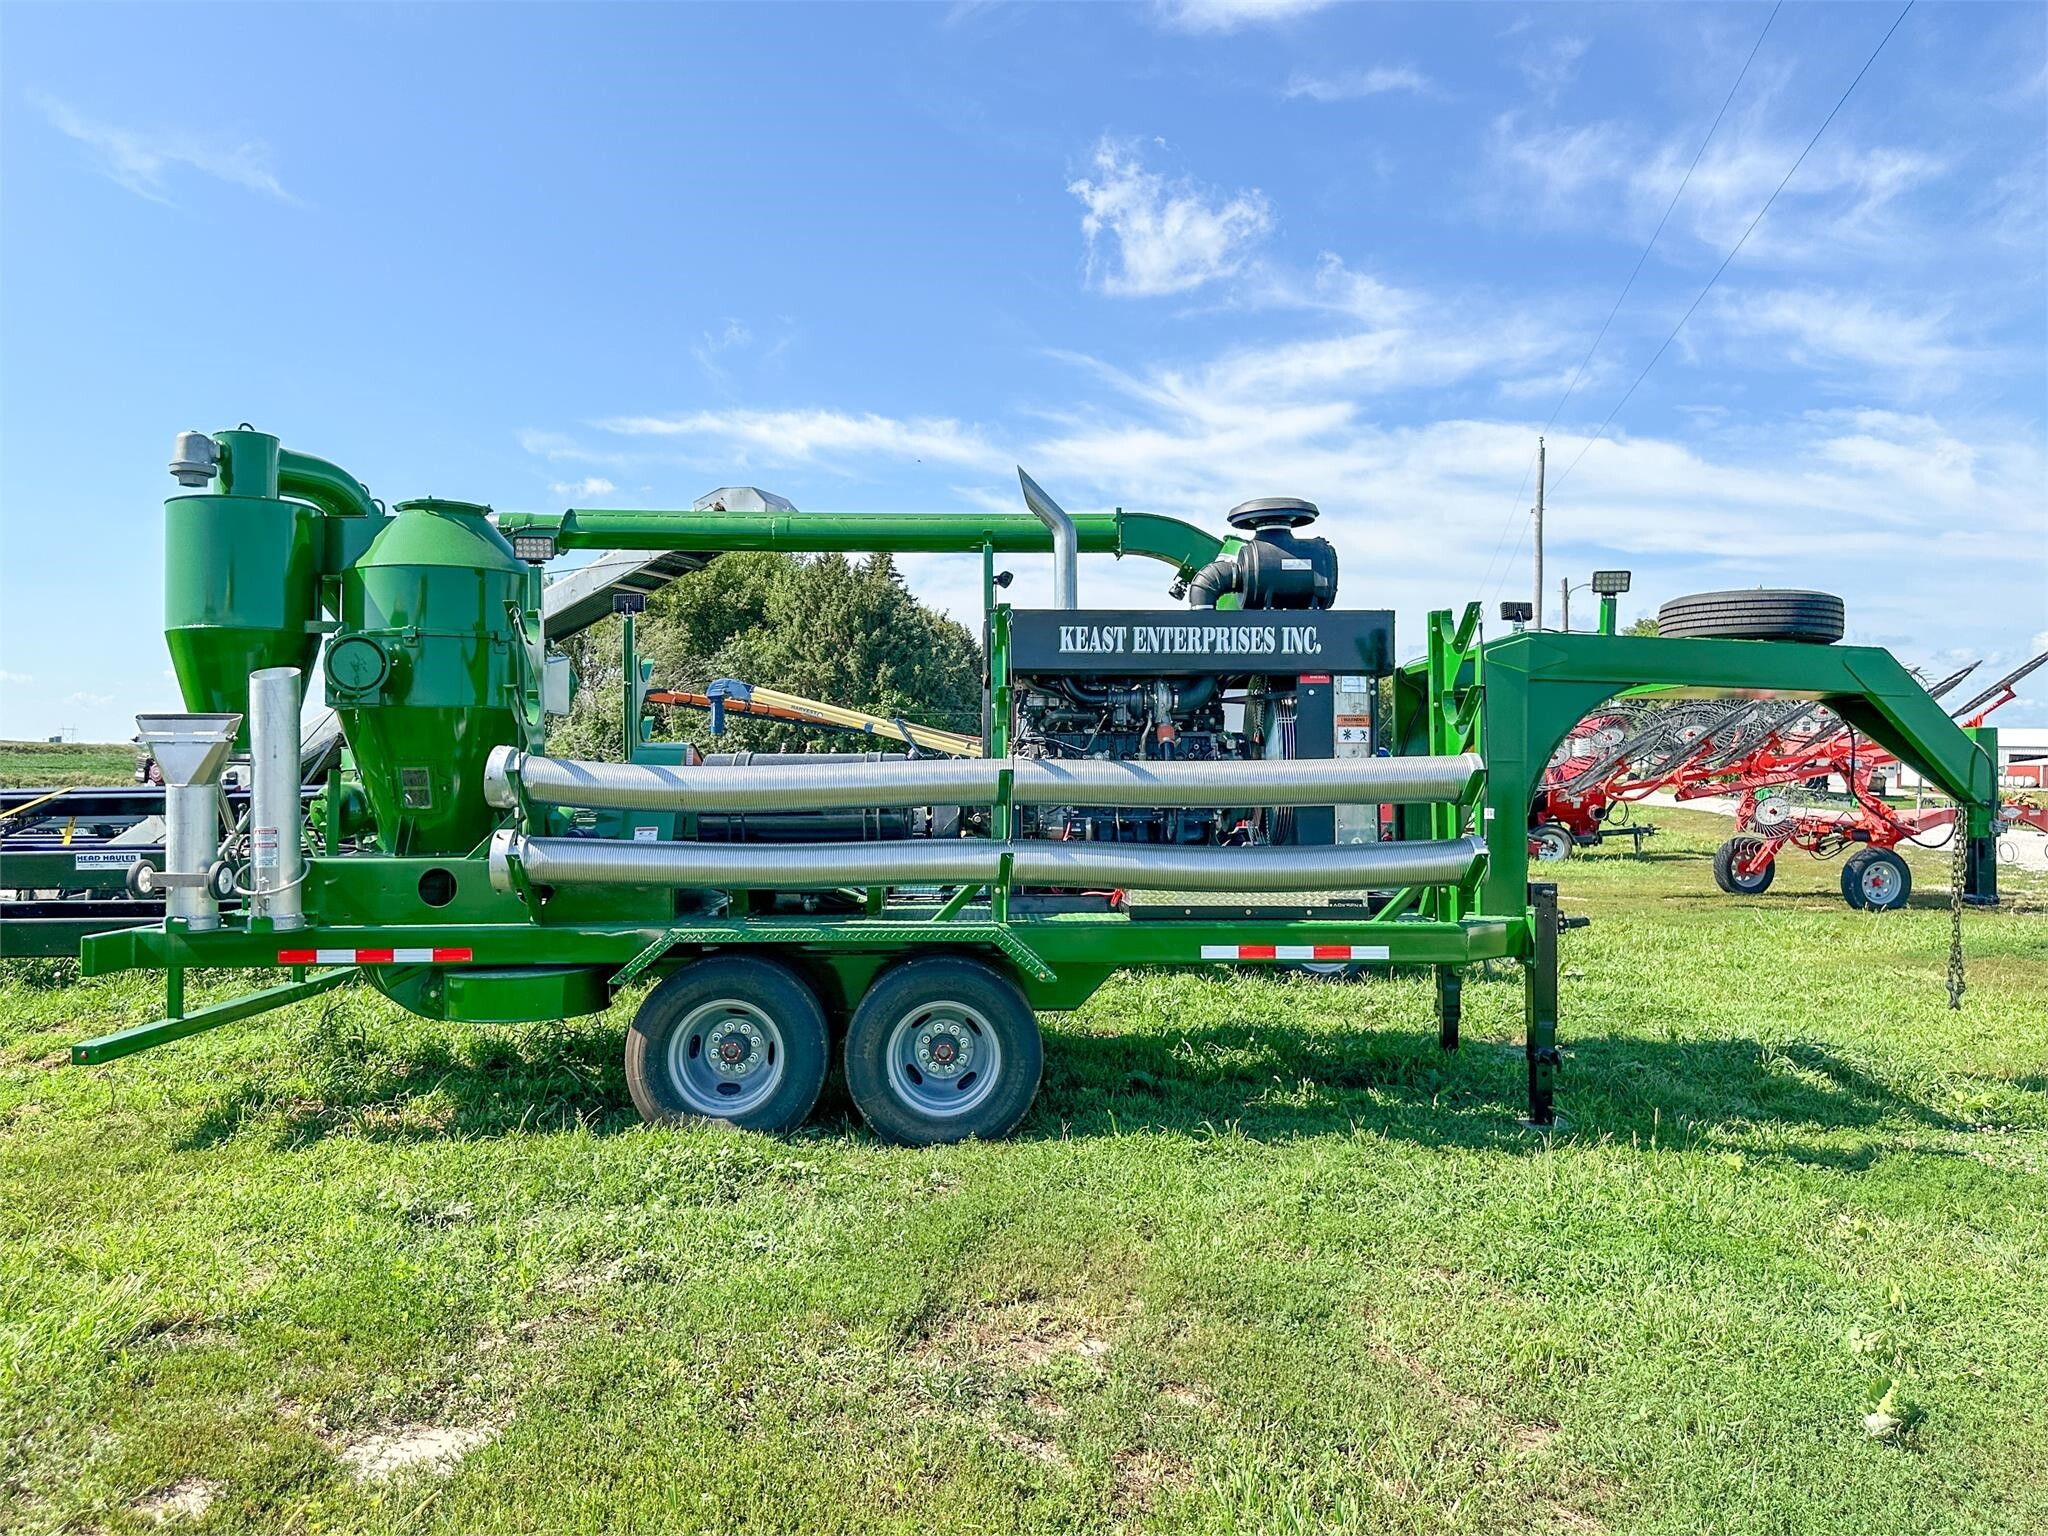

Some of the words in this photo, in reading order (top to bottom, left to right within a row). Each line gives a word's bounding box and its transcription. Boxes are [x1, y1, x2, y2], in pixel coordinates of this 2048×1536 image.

[1058, 626, 1127, 654] KEAST
[1132, 626, 1276, 654] ENTERPRISES
[1281, 626, 1322, 655] INC.
